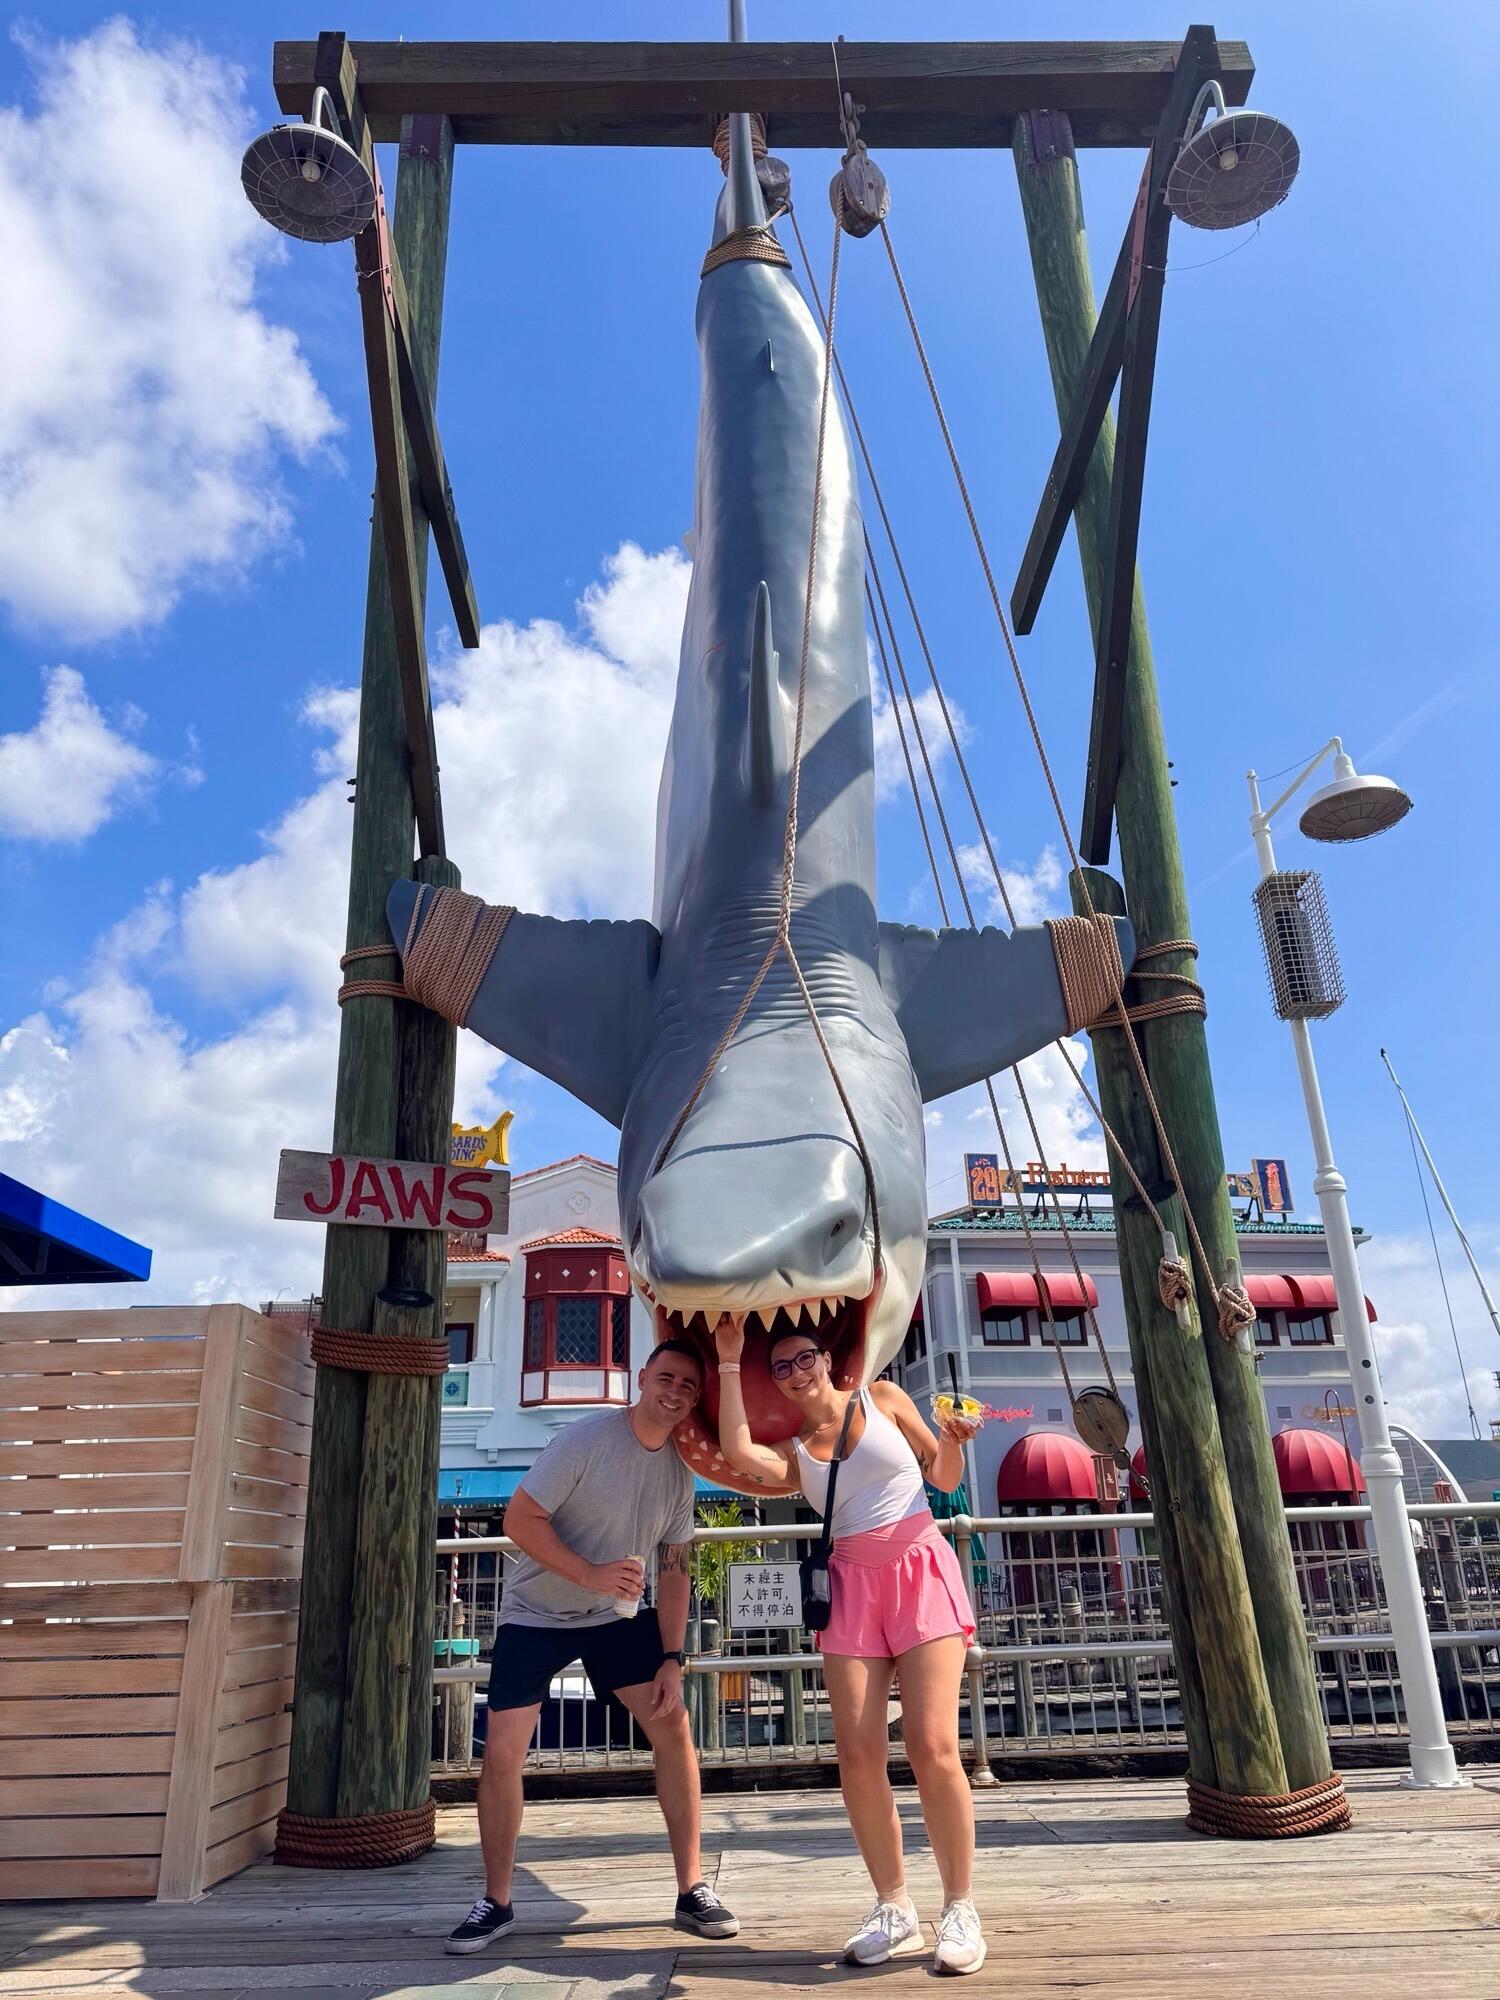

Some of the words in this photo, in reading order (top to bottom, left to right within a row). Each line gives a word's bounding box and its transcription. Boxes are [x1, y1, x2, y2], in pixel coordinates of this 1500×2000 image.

[303, 1157, 494, 1229] JAWS
[744, 1571, 785, 1585] 未經主
[738, 1603, 794, 1617] 不得停泊
